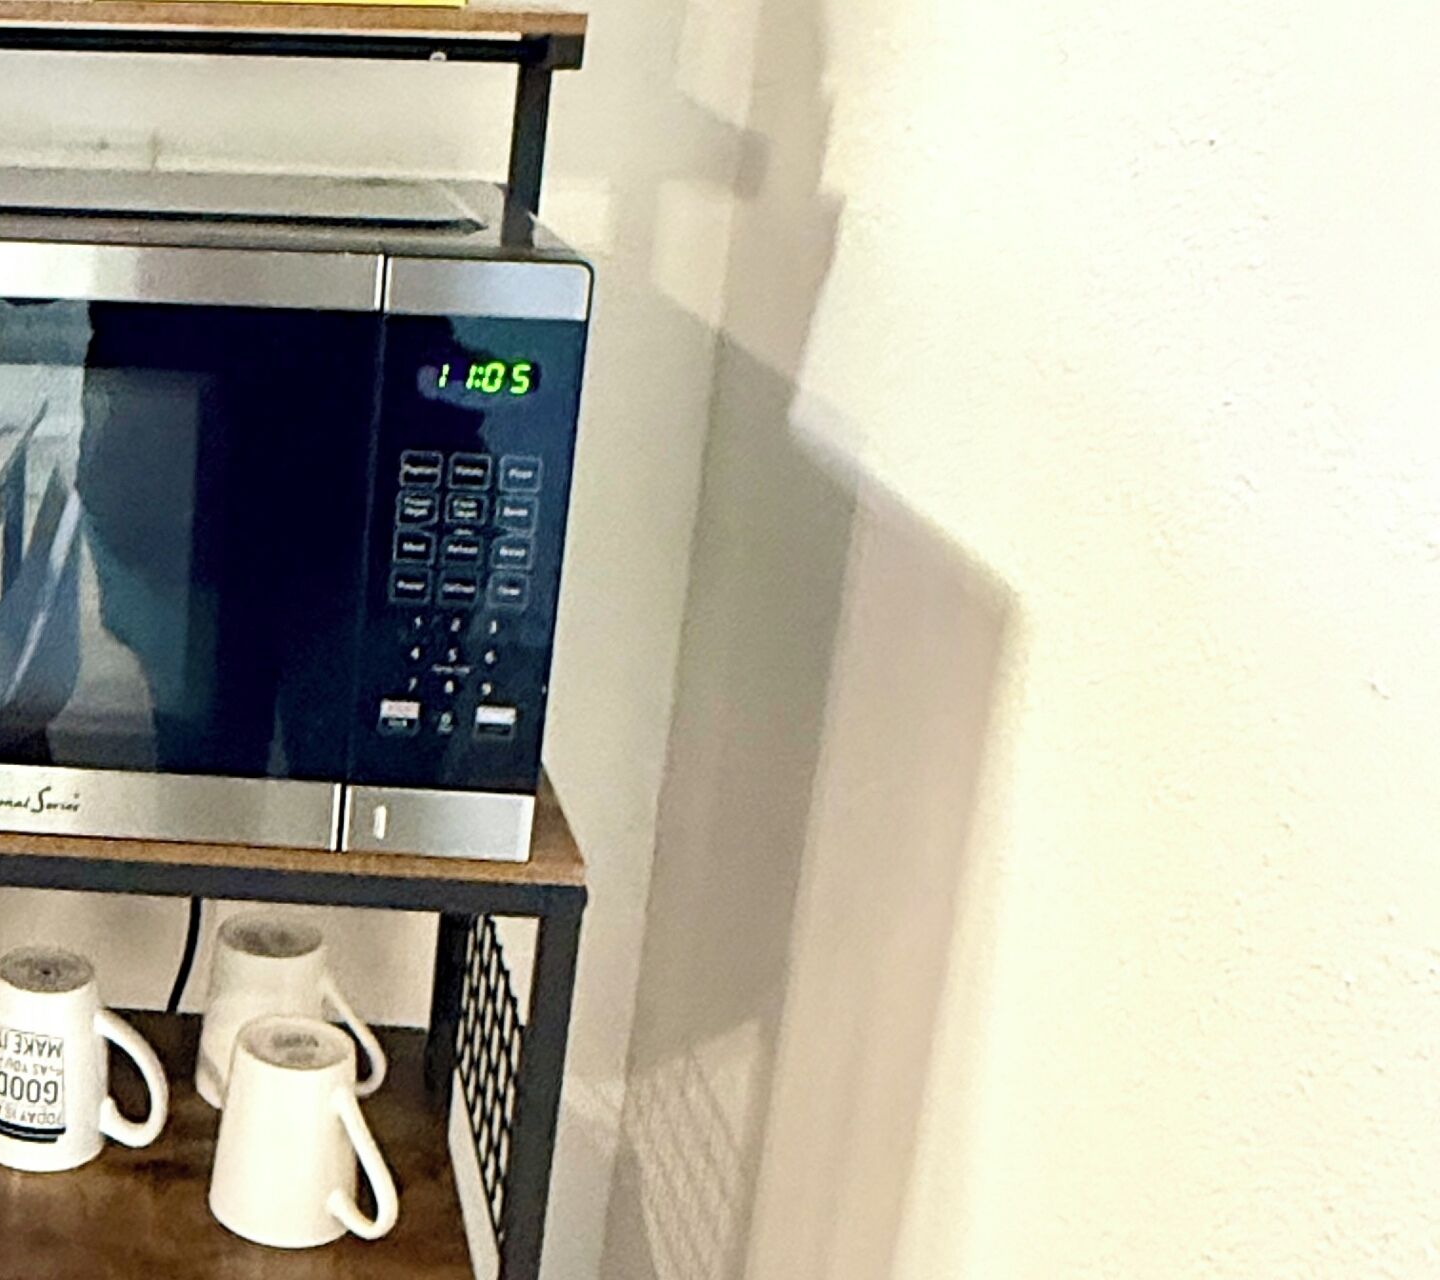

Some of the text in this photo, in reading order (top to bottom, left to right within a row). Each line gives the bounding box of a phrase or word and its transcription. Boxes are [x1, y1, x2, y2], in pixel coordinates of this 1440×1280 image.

[439, 363, 531, 394] 11:05
[30, 785, 80, 813] Series
[13, 1033, 64, 1058] MAKE
